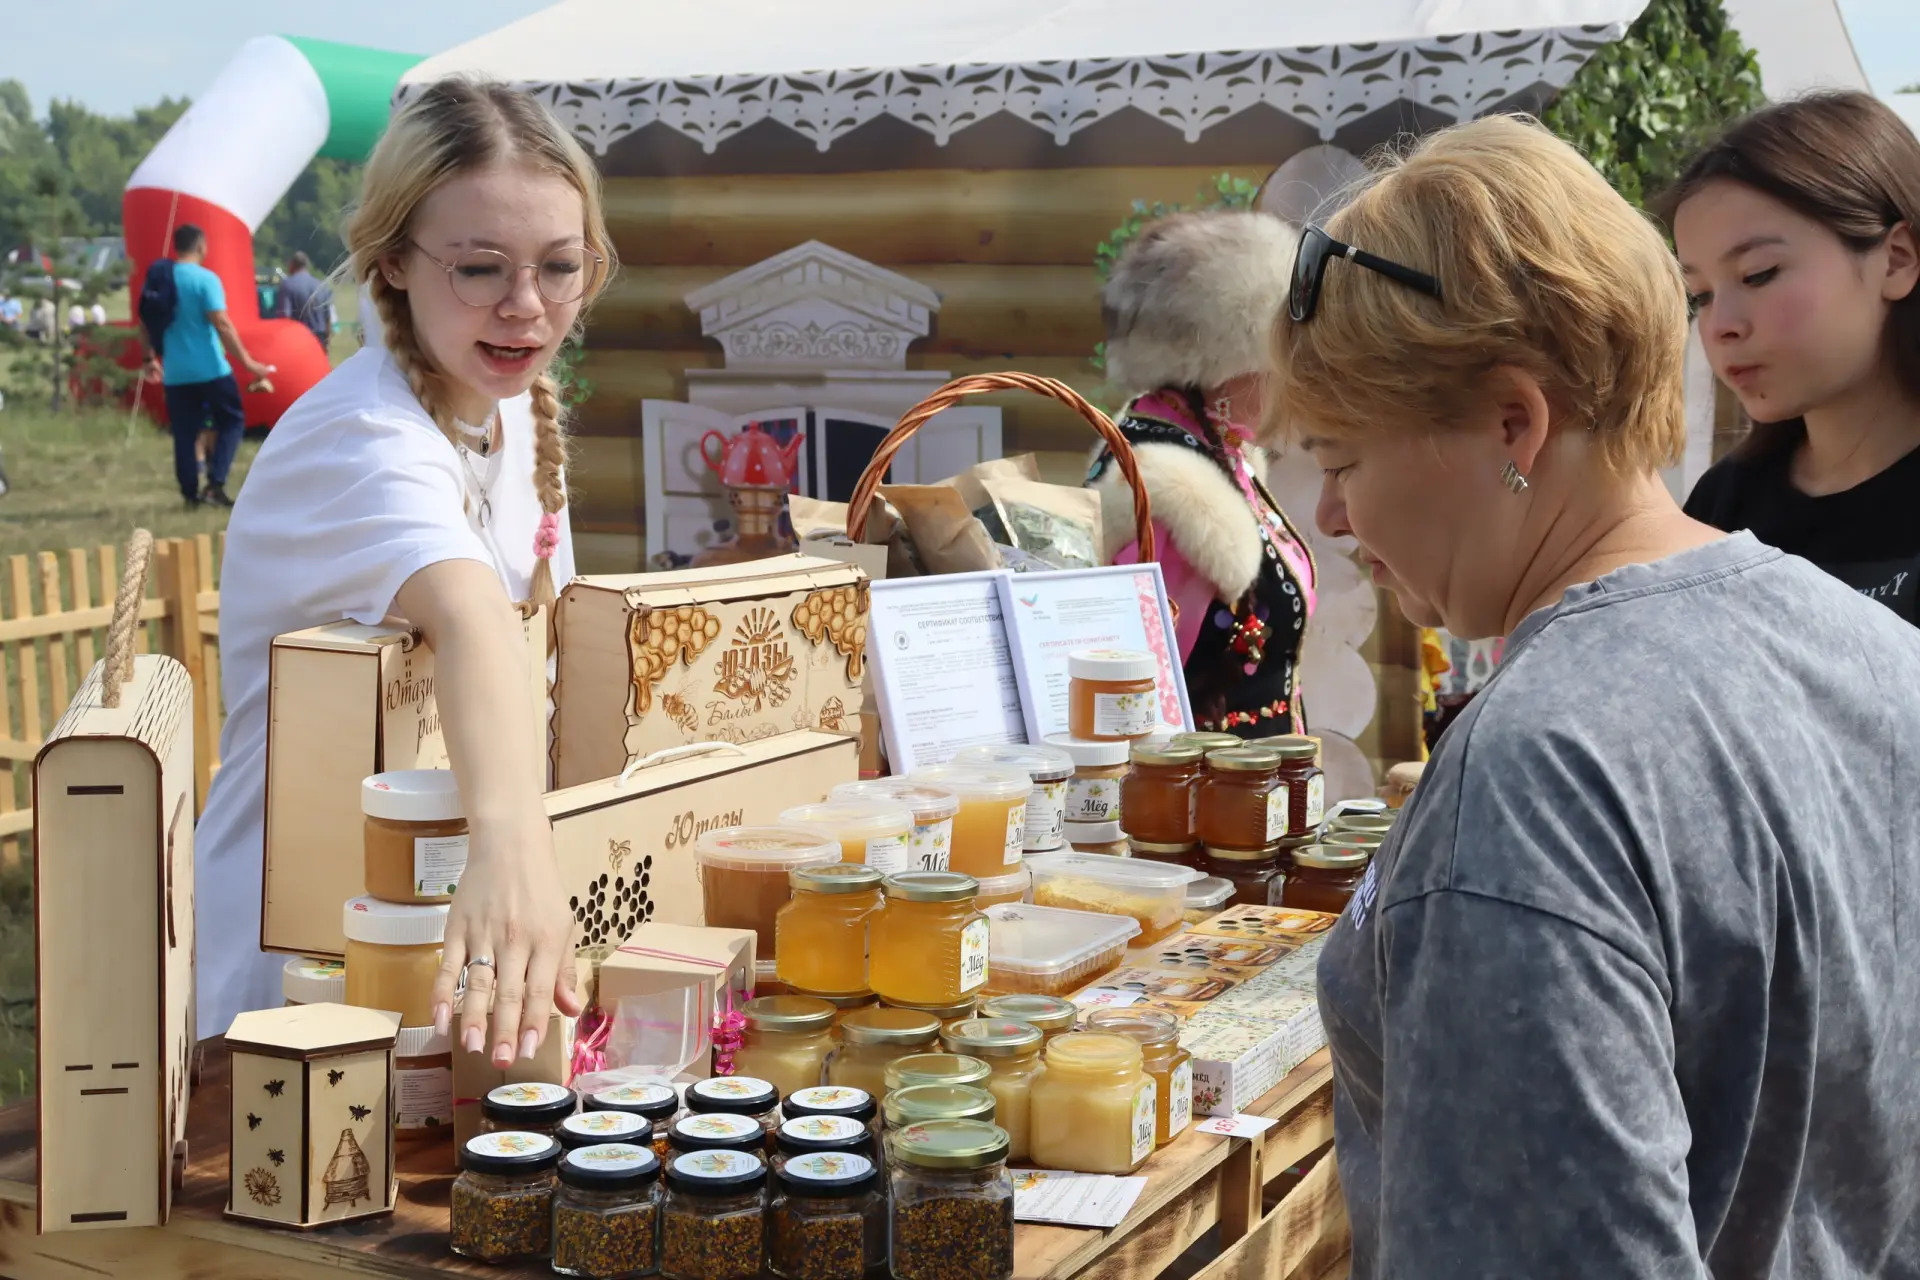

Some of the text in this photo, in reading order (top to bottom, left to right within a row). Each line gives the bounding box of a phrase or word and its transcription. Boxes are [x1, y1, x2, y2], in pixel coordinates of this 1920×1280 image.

[722, 641, 788, 677] ЮТАЗЫ
[386, 677, 433, 714] Ютази
[1081, 799, 1108, 817] Мёд
[966, 953, 985, 975] Мёд
